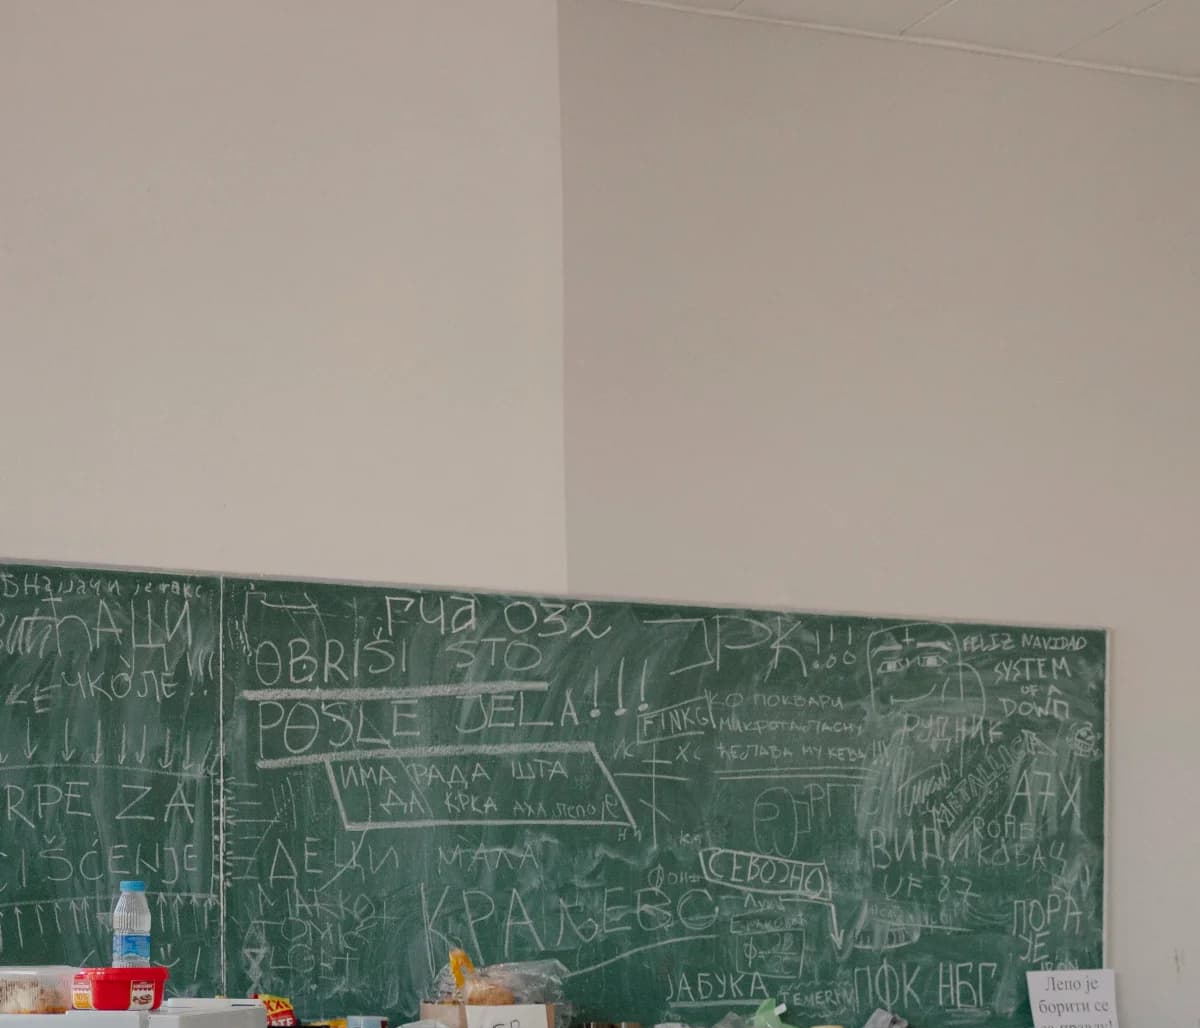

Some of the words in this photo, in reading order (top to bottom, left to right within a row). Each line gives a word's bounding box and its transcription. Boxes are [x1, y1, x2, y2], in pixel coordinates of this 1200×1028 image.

[963, 633, 1015, 651] FELIZ
[1022, 633, 1088, 651] NAVIDAD
[994, 657, 1072, 685] SYSTEM
[753, 694, 845, 709] ПОКВАРИ
[1048, 684, 1064, 697] A
[258, 699, 422, 760] POSLE
[341, 762, 399, 789] ИМА
[408, 762, 492, 791] РАДА
[511, 760, 569, 781] ШТА
[0, 834, 199, 889] IŠĆENJE
[665, 971, 770, 1002] ЈАБУКА
[854, 957, 921, 1013] ПФК
[938, 962, 998, 1010] НБГ
[1044, 976, 1082, 992] Лепо
[1084, 975, 1100, 994] је
[1038, 999, 1090, 1016] борити
[1094, 1000, 1110, 1012] се
